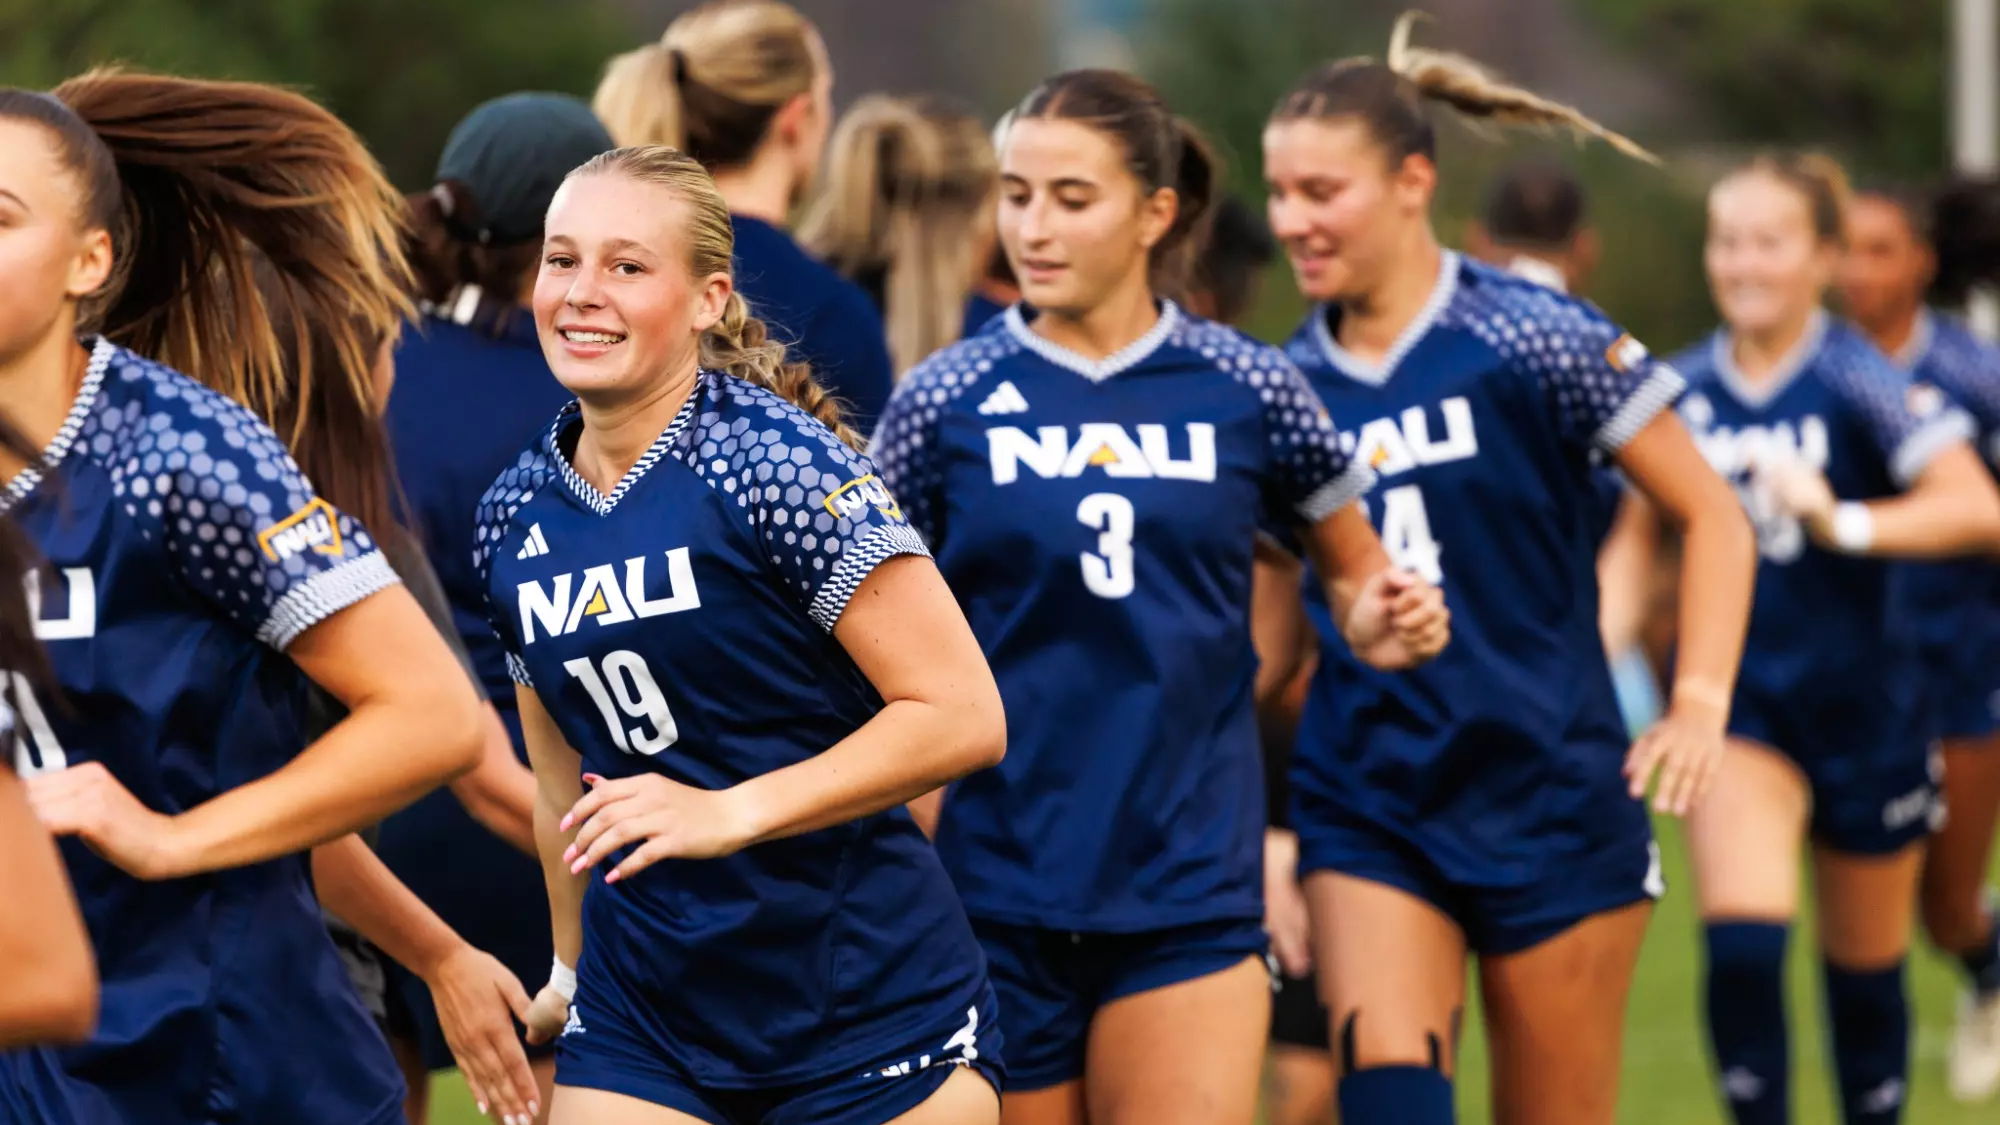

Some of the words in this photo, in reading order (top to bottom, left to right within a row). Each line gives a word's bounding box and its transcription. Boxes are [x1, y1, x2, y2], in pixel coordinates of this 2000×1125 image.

[985, 422, 1217, 486] NAU
[1354, 396, 1479, 477] AU
[271, 513, 332, 560] NAU
[836, 486, 890, 518] NAU
[1076, 492, 1135, 599] 3
[1357, 484, 1444, 585] 4
[516, 546, 701, 646] NAU
[562, 649, 679, 756] 19
